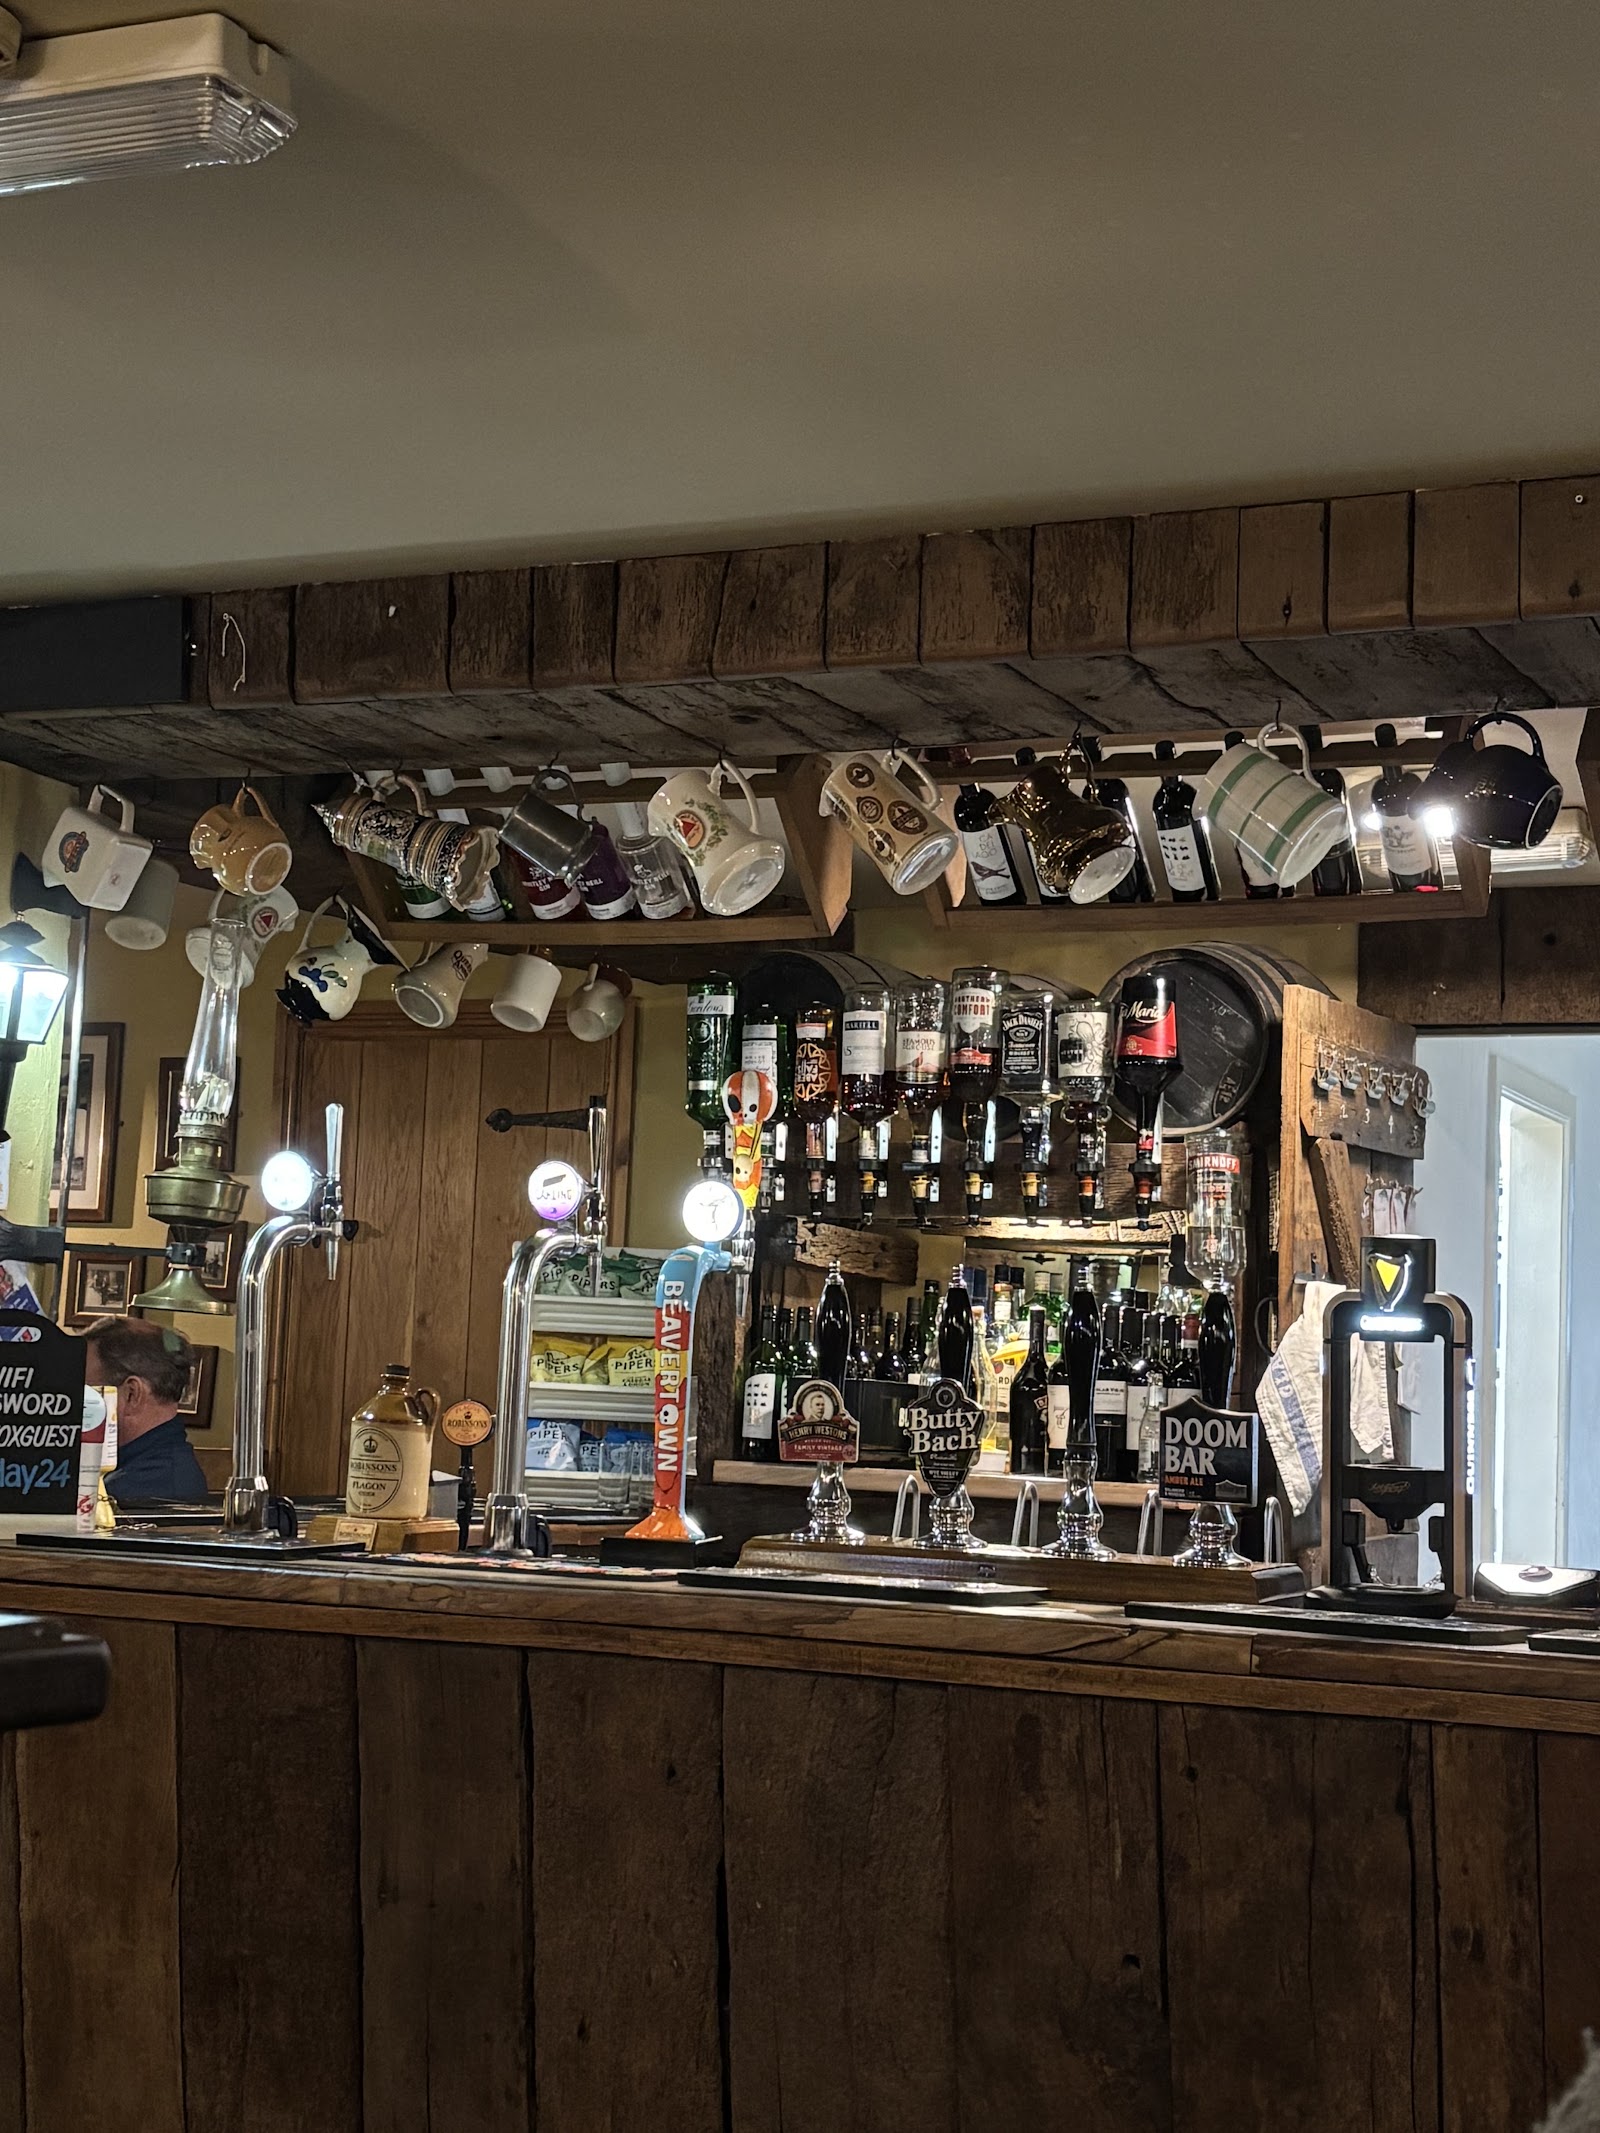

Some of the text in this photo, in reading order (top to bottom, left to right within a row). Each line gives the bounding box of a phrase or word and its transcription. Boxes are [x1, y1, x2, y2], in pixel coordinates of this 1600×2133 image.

[954, 1003, 990, 1016] COMFORT
[1126, 1000, 1167, 1020] Maria
[1002, 1016, 1020, 1032] JACK
[1188, 1155, 1238, 1171] SMIRNOFF
[614, 1357, 655, 1371] PIPER
[657, 1280, 685, 1472] BEAVERTOWN
[0, 1392, 72, 1416] WORD
[908, 1406, 983, 1431] Butty
[788, 1425, 848, 1440] HENRY WESTONS
[910, 1426, 979, 1454] Bach
[1164, 1416, 1248, 1449] DOOM
[1164, 1444, 1218, 1476] BAR
[352, 1480, 387, 1491] FLAGON
[1164, 1475, 1204, 1487] AMBER ALE
